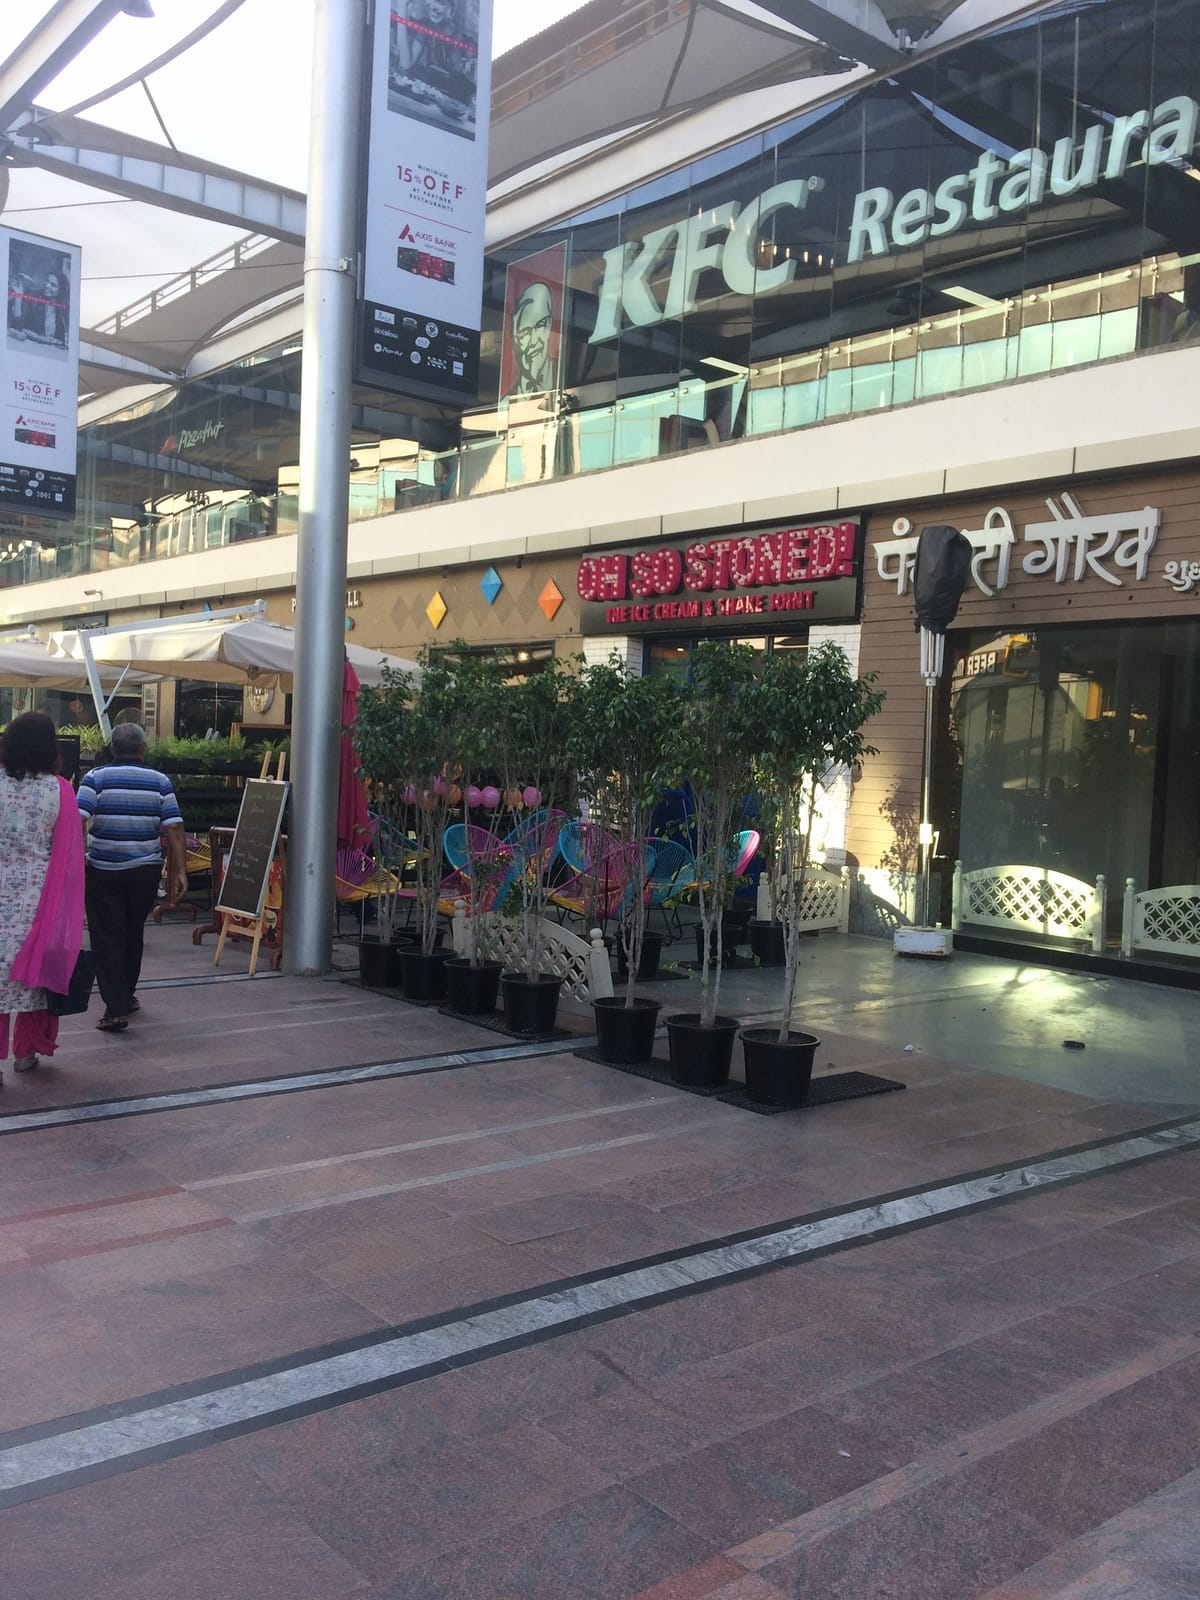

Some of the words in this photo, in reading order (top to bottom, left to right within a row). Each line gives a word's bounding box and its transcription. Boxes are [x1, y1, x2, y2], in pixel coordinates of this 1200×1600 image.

[409, 194, 454, 213] RESTAURANTS
[423, 191, 452, 204] PARTNER
[588, 178, 809, 344] KFC
[847, 95, 1200, 263] Restaura
[415, 231, 433, 242] AXIS
[434, 237, 457, 249] BANK
[1023, 491, 1163, 586] गौरव
[577, 553, 628, 601] OH
[629, 547, 683, 597] SO
[682, 522, 859, 591] STONED!
[605, 605, 628, 624] THE
[631, 604, 650, 621] ICE
[653, 601, 698, 620] CREAM
[703, 599, 713, 617] &
[717, 595, 763, 615] SHAKE
[767, 591, 814, 612] JOINT
